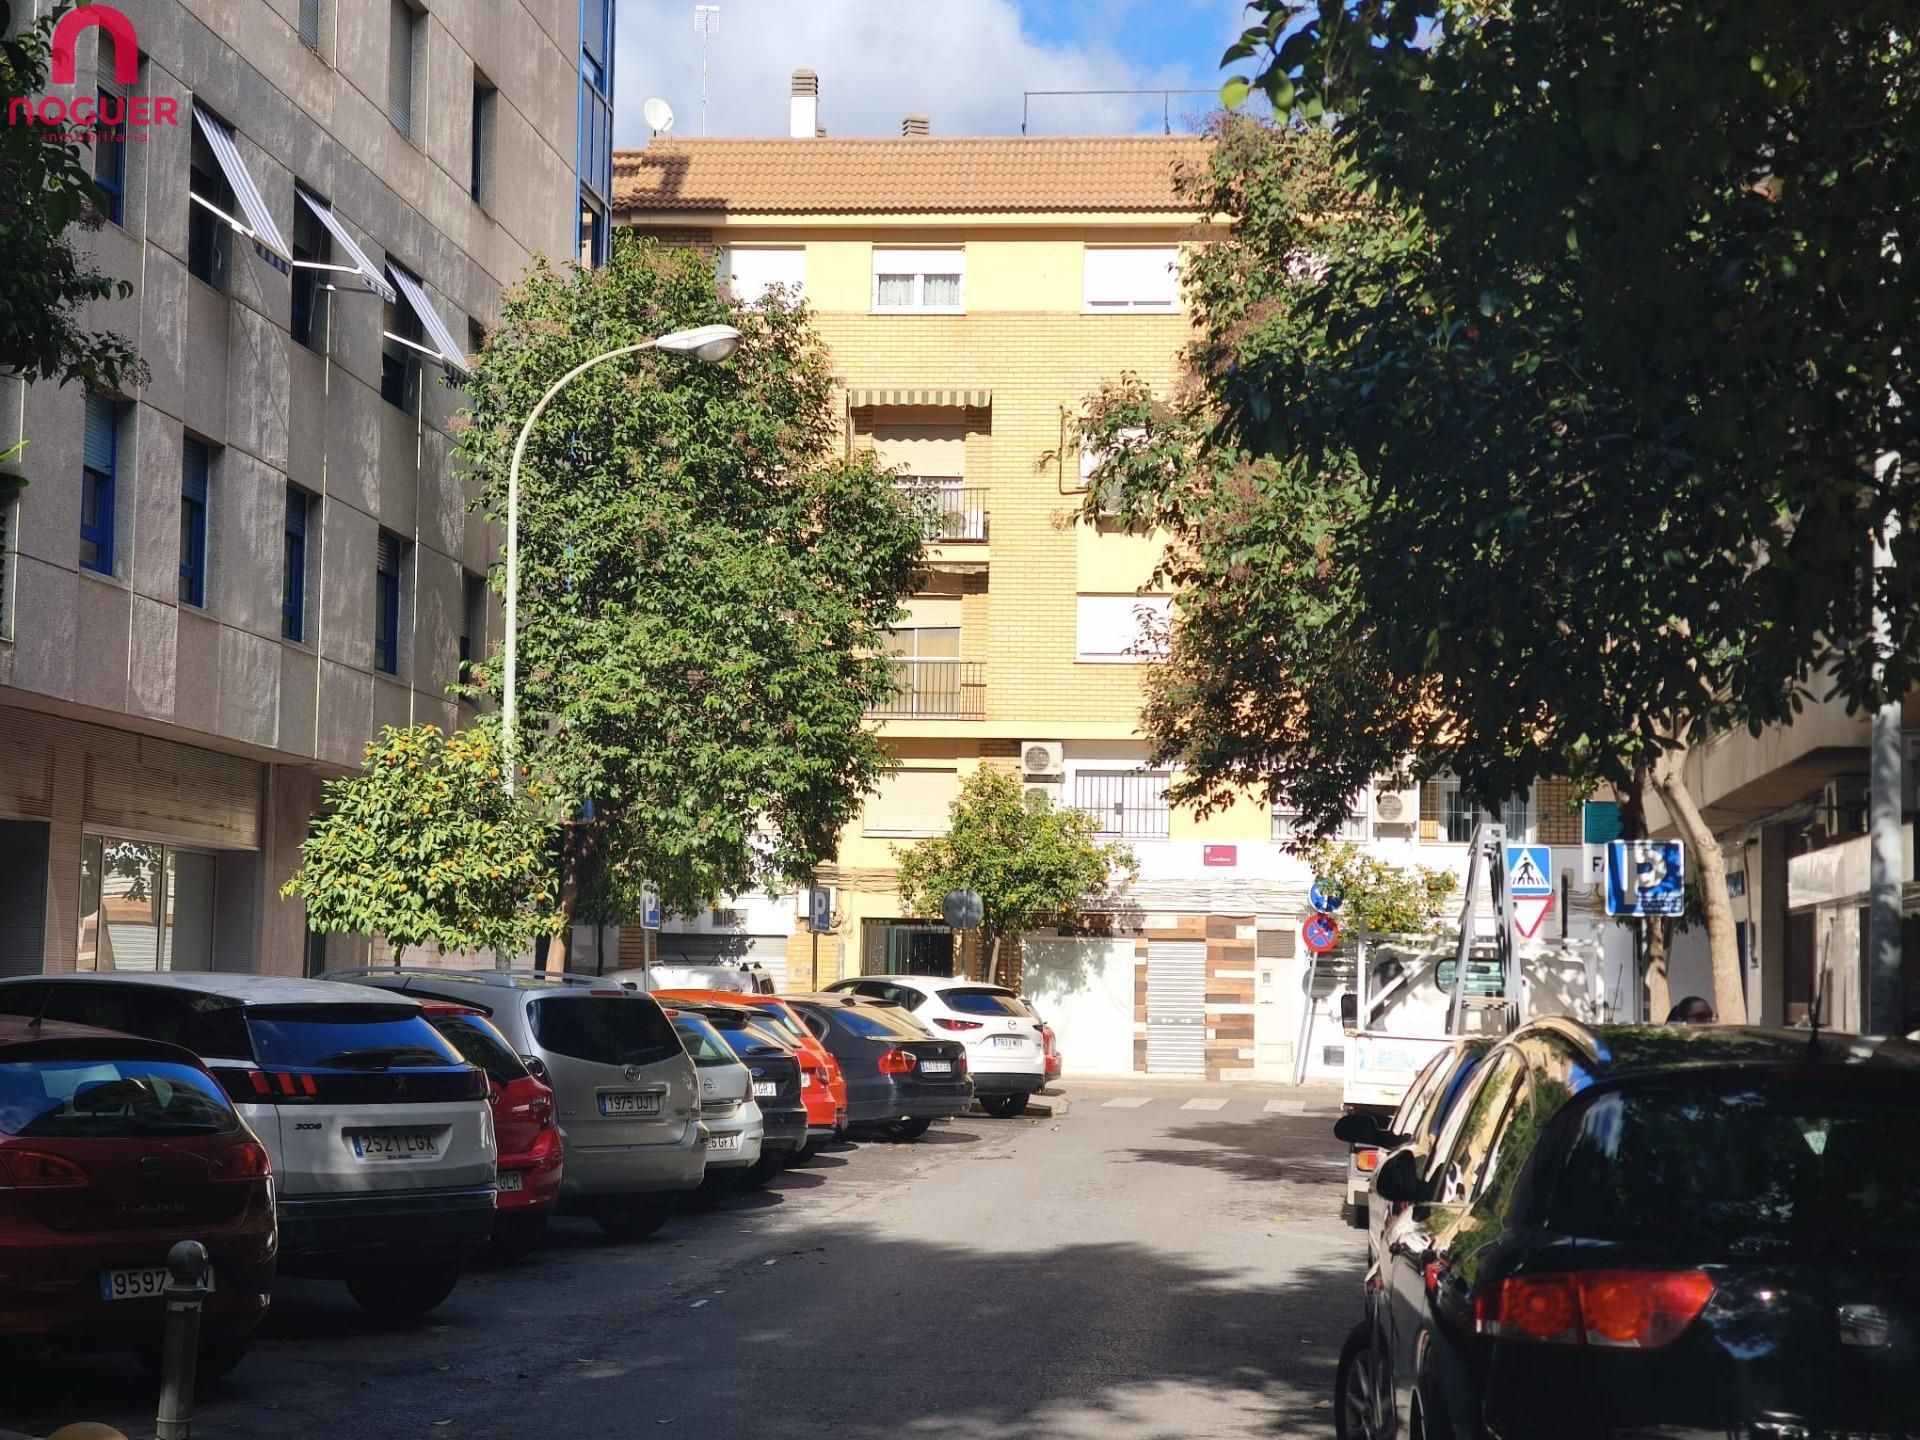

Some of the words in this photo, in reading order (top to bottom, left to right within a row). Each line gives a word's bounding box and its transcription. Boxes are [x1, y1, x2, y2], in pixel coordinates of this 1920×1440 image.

[814, 891, 827, 925] P
[1378, 1057, 1415, 1069] ROOM
[609, 1095, 633, 1110] 1975
[364, 1136, 401, 1153] 2521
[405, 1135, 434, 1150] LGX
[114, 1270, 166, 1295] 9597
